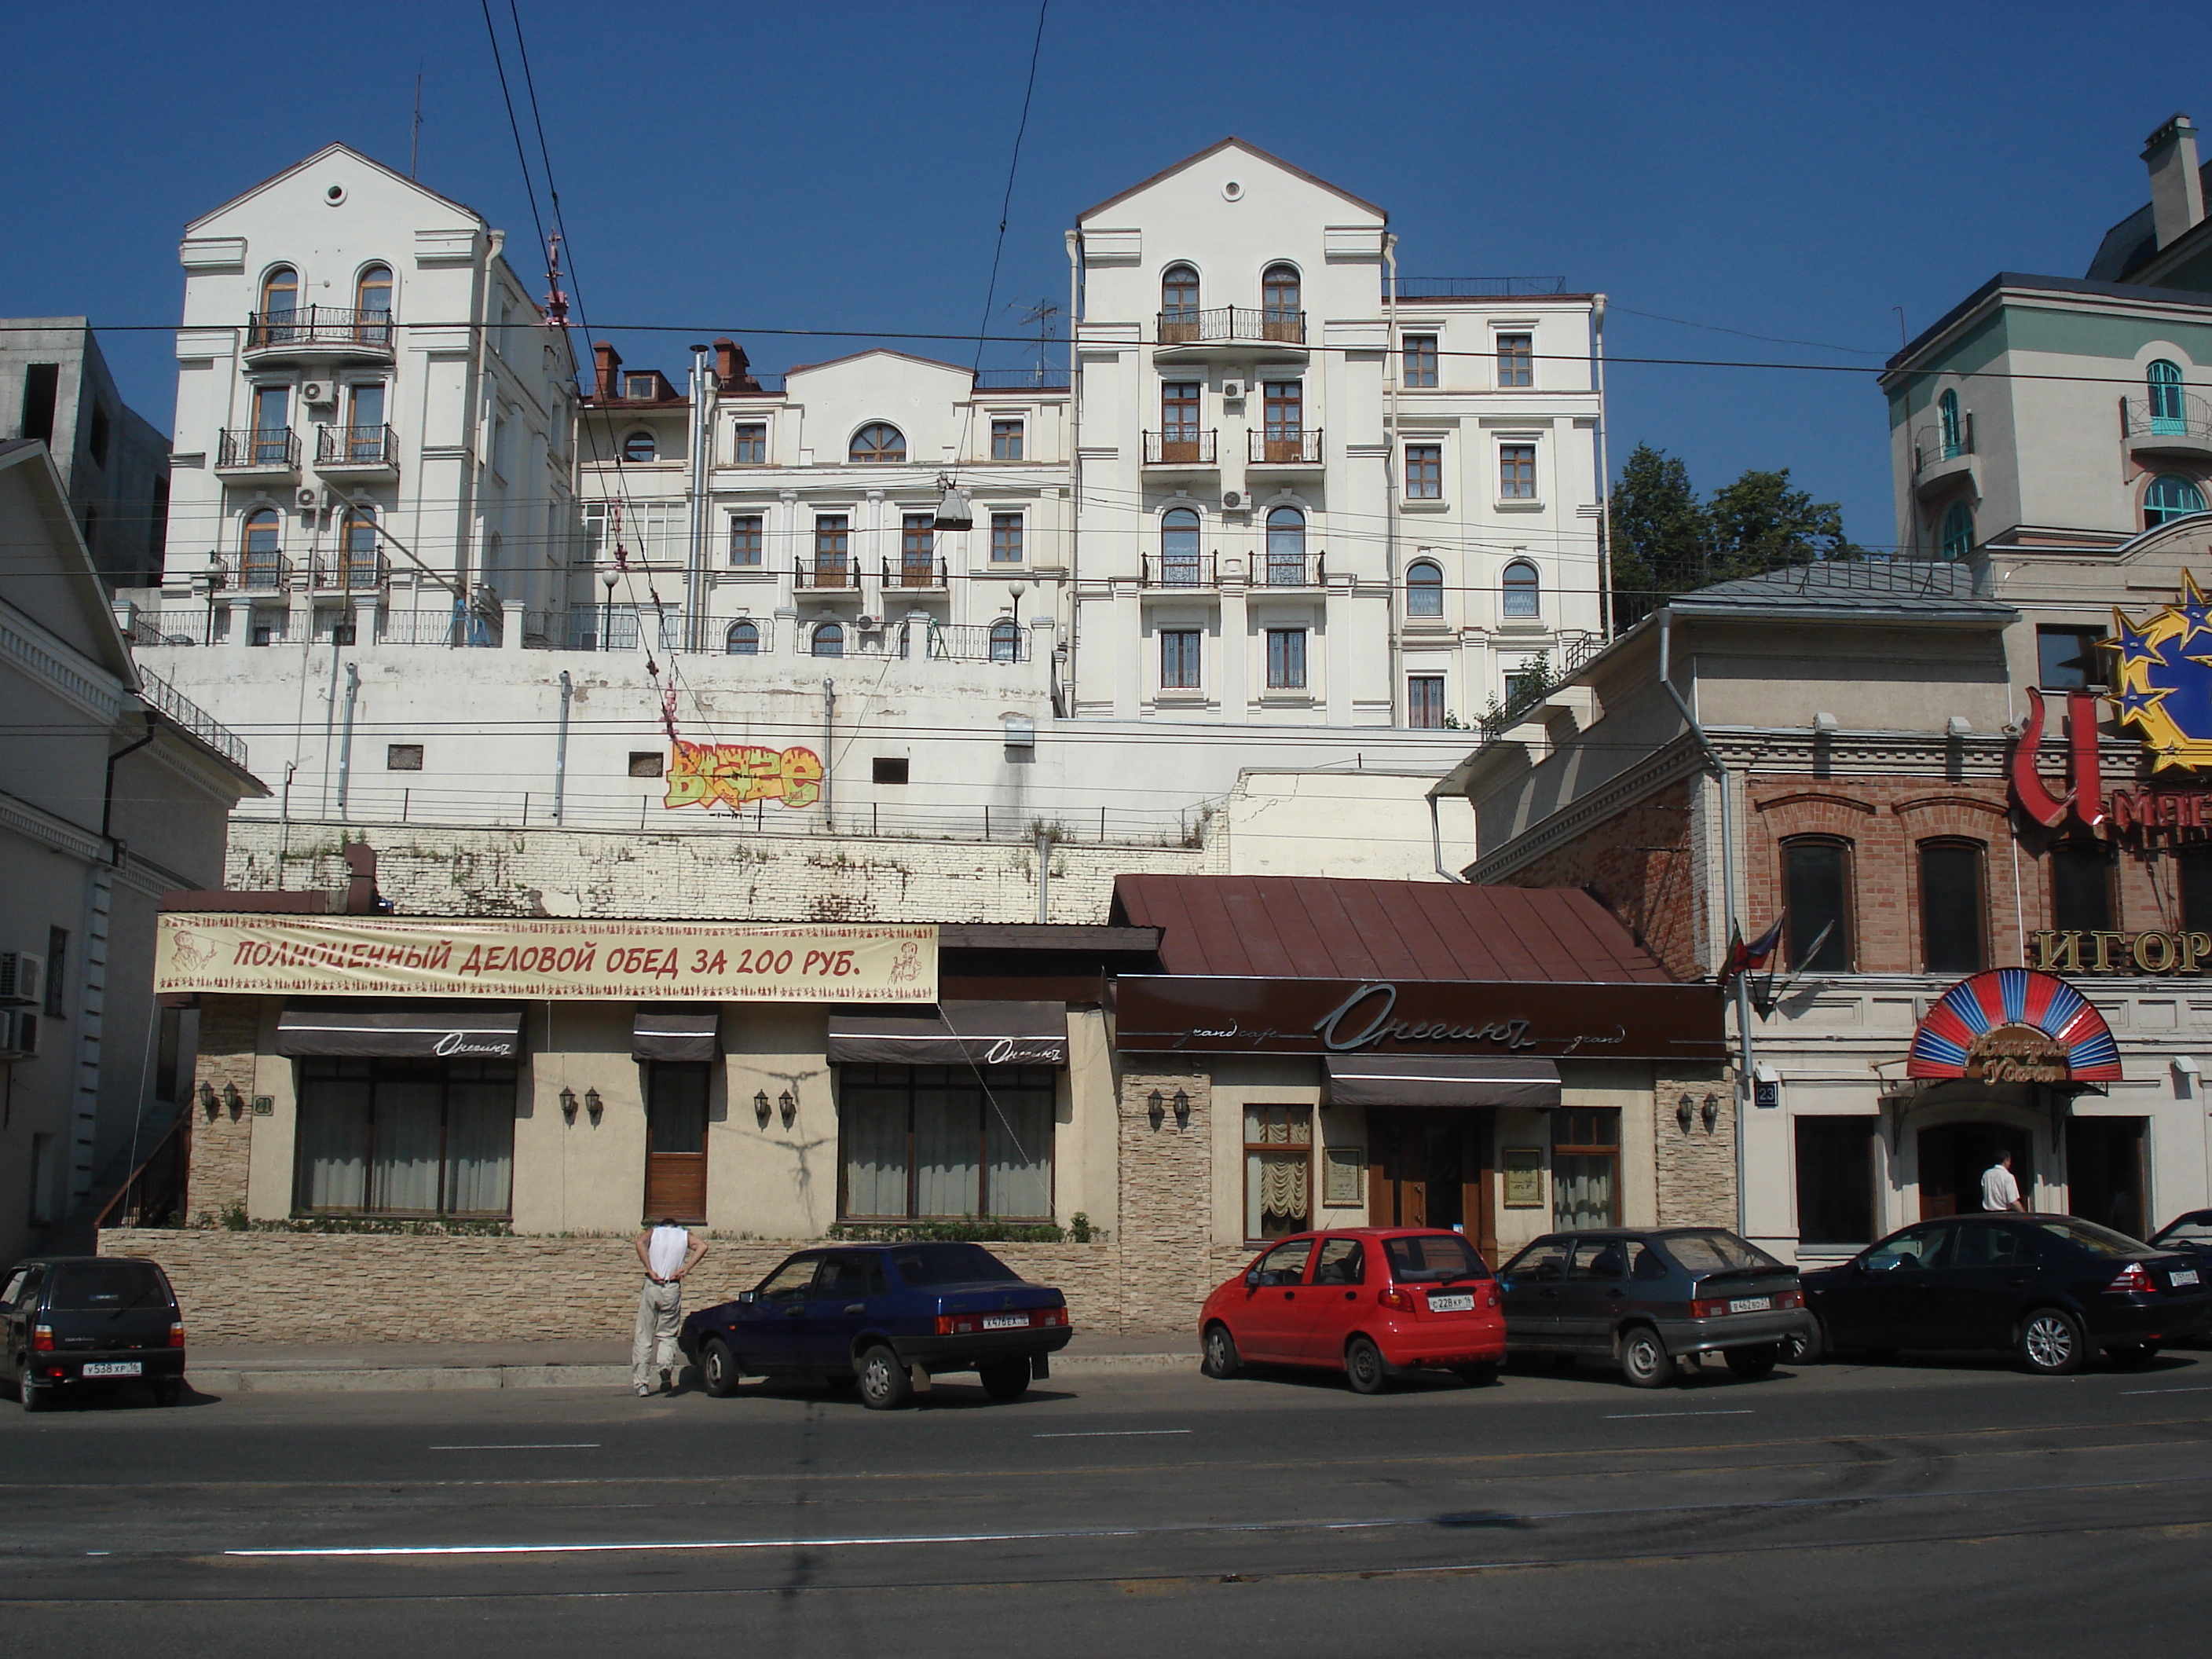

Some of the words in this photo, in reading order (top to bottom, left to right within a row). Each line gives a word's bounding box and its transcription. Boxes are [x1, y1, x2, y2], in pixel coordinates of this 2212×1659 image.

[233, 939, 453, 972] ПОЛНОЦЕННЫЙ
[459, 941, 598, 976] ДЕЛОВОЙ
[606, 946, 679, 980] ОБЕД
[691, 947, 728, 975] ЗА
[736, 949, 793, 976] 200
[802, 949, 861, 977] РУБ.
[2035, 929, 2212, 972] ИГОР
[1173, 1018, 1238, 1048] grand
[1239, 1027, 1278, 1046] cafe
[1563, 1024, 1626, 1054] grand
[1759, 1088, 1774, 1101] 23
